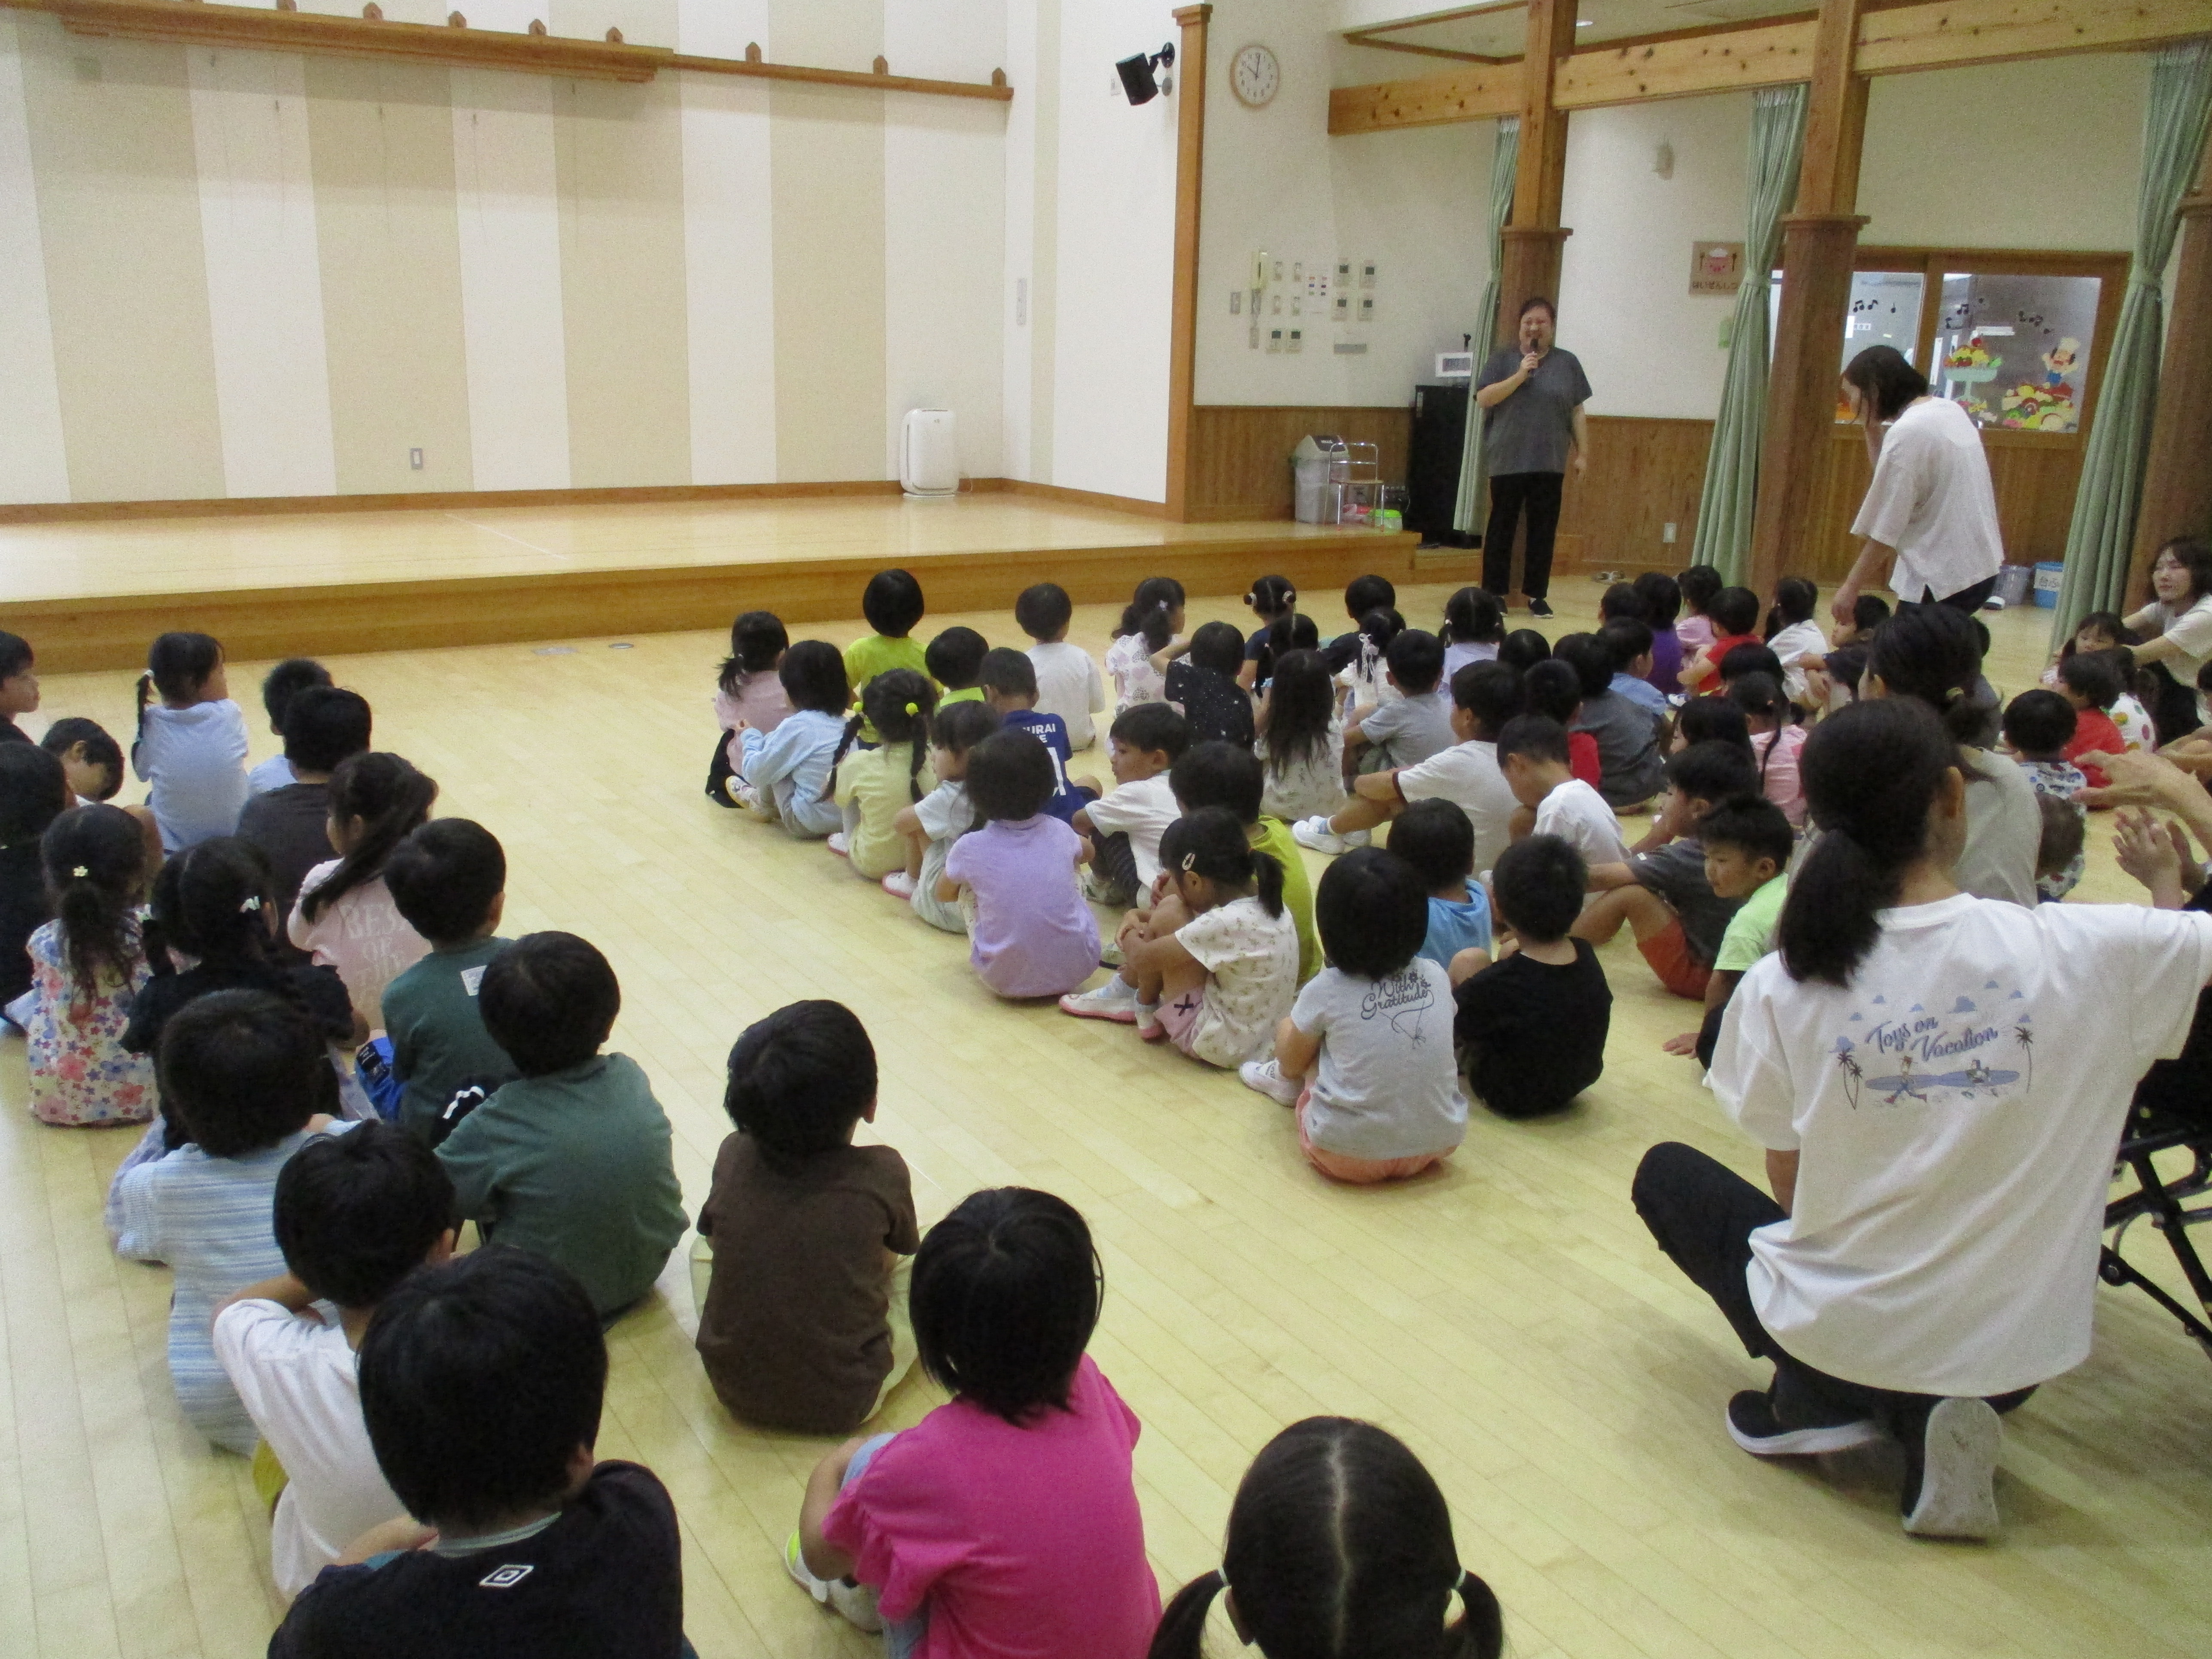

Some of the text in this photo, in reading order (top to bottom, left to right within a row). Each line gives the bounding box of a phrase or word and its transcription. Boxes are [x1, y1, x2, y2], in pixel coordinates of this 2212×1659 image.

[1361, 983, 1429, 1020] Gratitude
[1864, 1016, 1939, 1054] Toys on
[1909, 1027, 1999, 1062] Vacation
